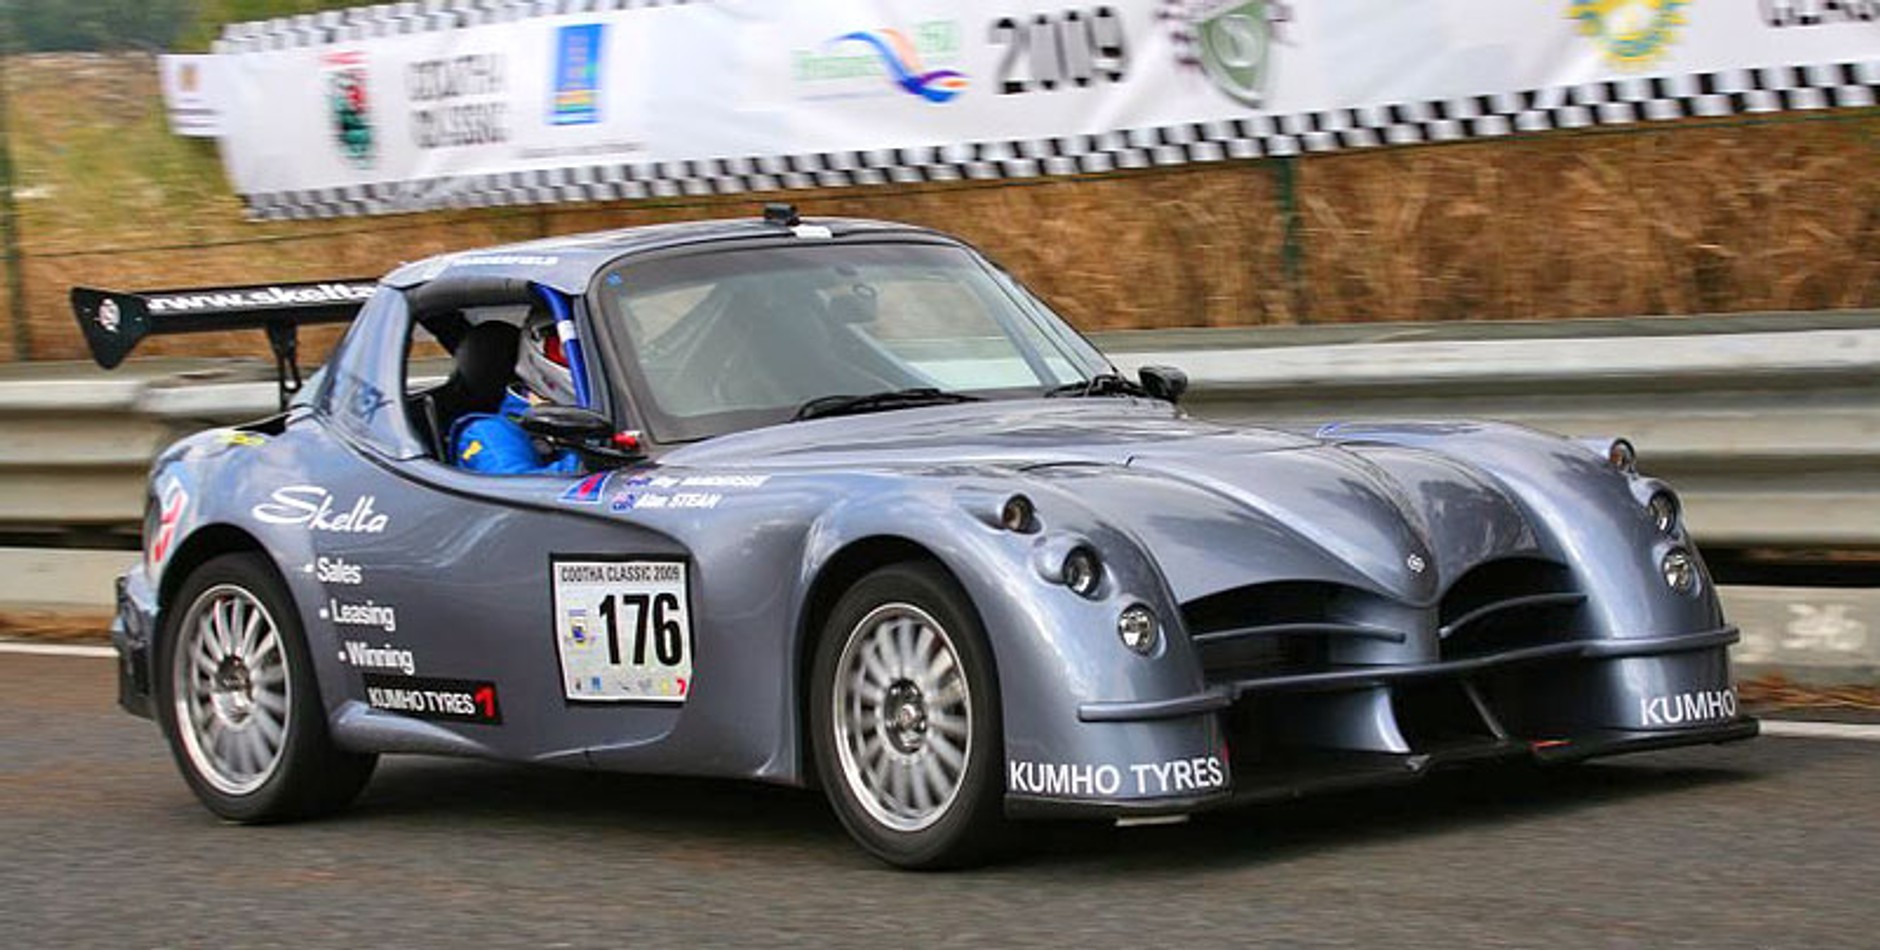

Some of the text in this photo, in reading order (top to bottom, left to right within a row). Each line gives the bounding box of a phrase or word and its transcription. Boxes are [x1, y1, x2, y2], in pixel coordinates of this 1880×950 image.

[990, 6, 1130, 95] 2009
[252, 484, 389, 533] Skelta
[317, 557, 362, 584] Sales
[561, 564, 680, 582] COOTHA CLASSIC 2009
[331, 598, 396, 632] Leasing
[599, 593, 683, 667] 176
[345, 641, 415, 676] Winning
[367, 686, 426, 712] KUMHO
[423, 691, 476, 714] TYRES
[1640, 692, 1737, 726] KUMHO
[1009, 756, 1224, 795] KUMHO TYRES
